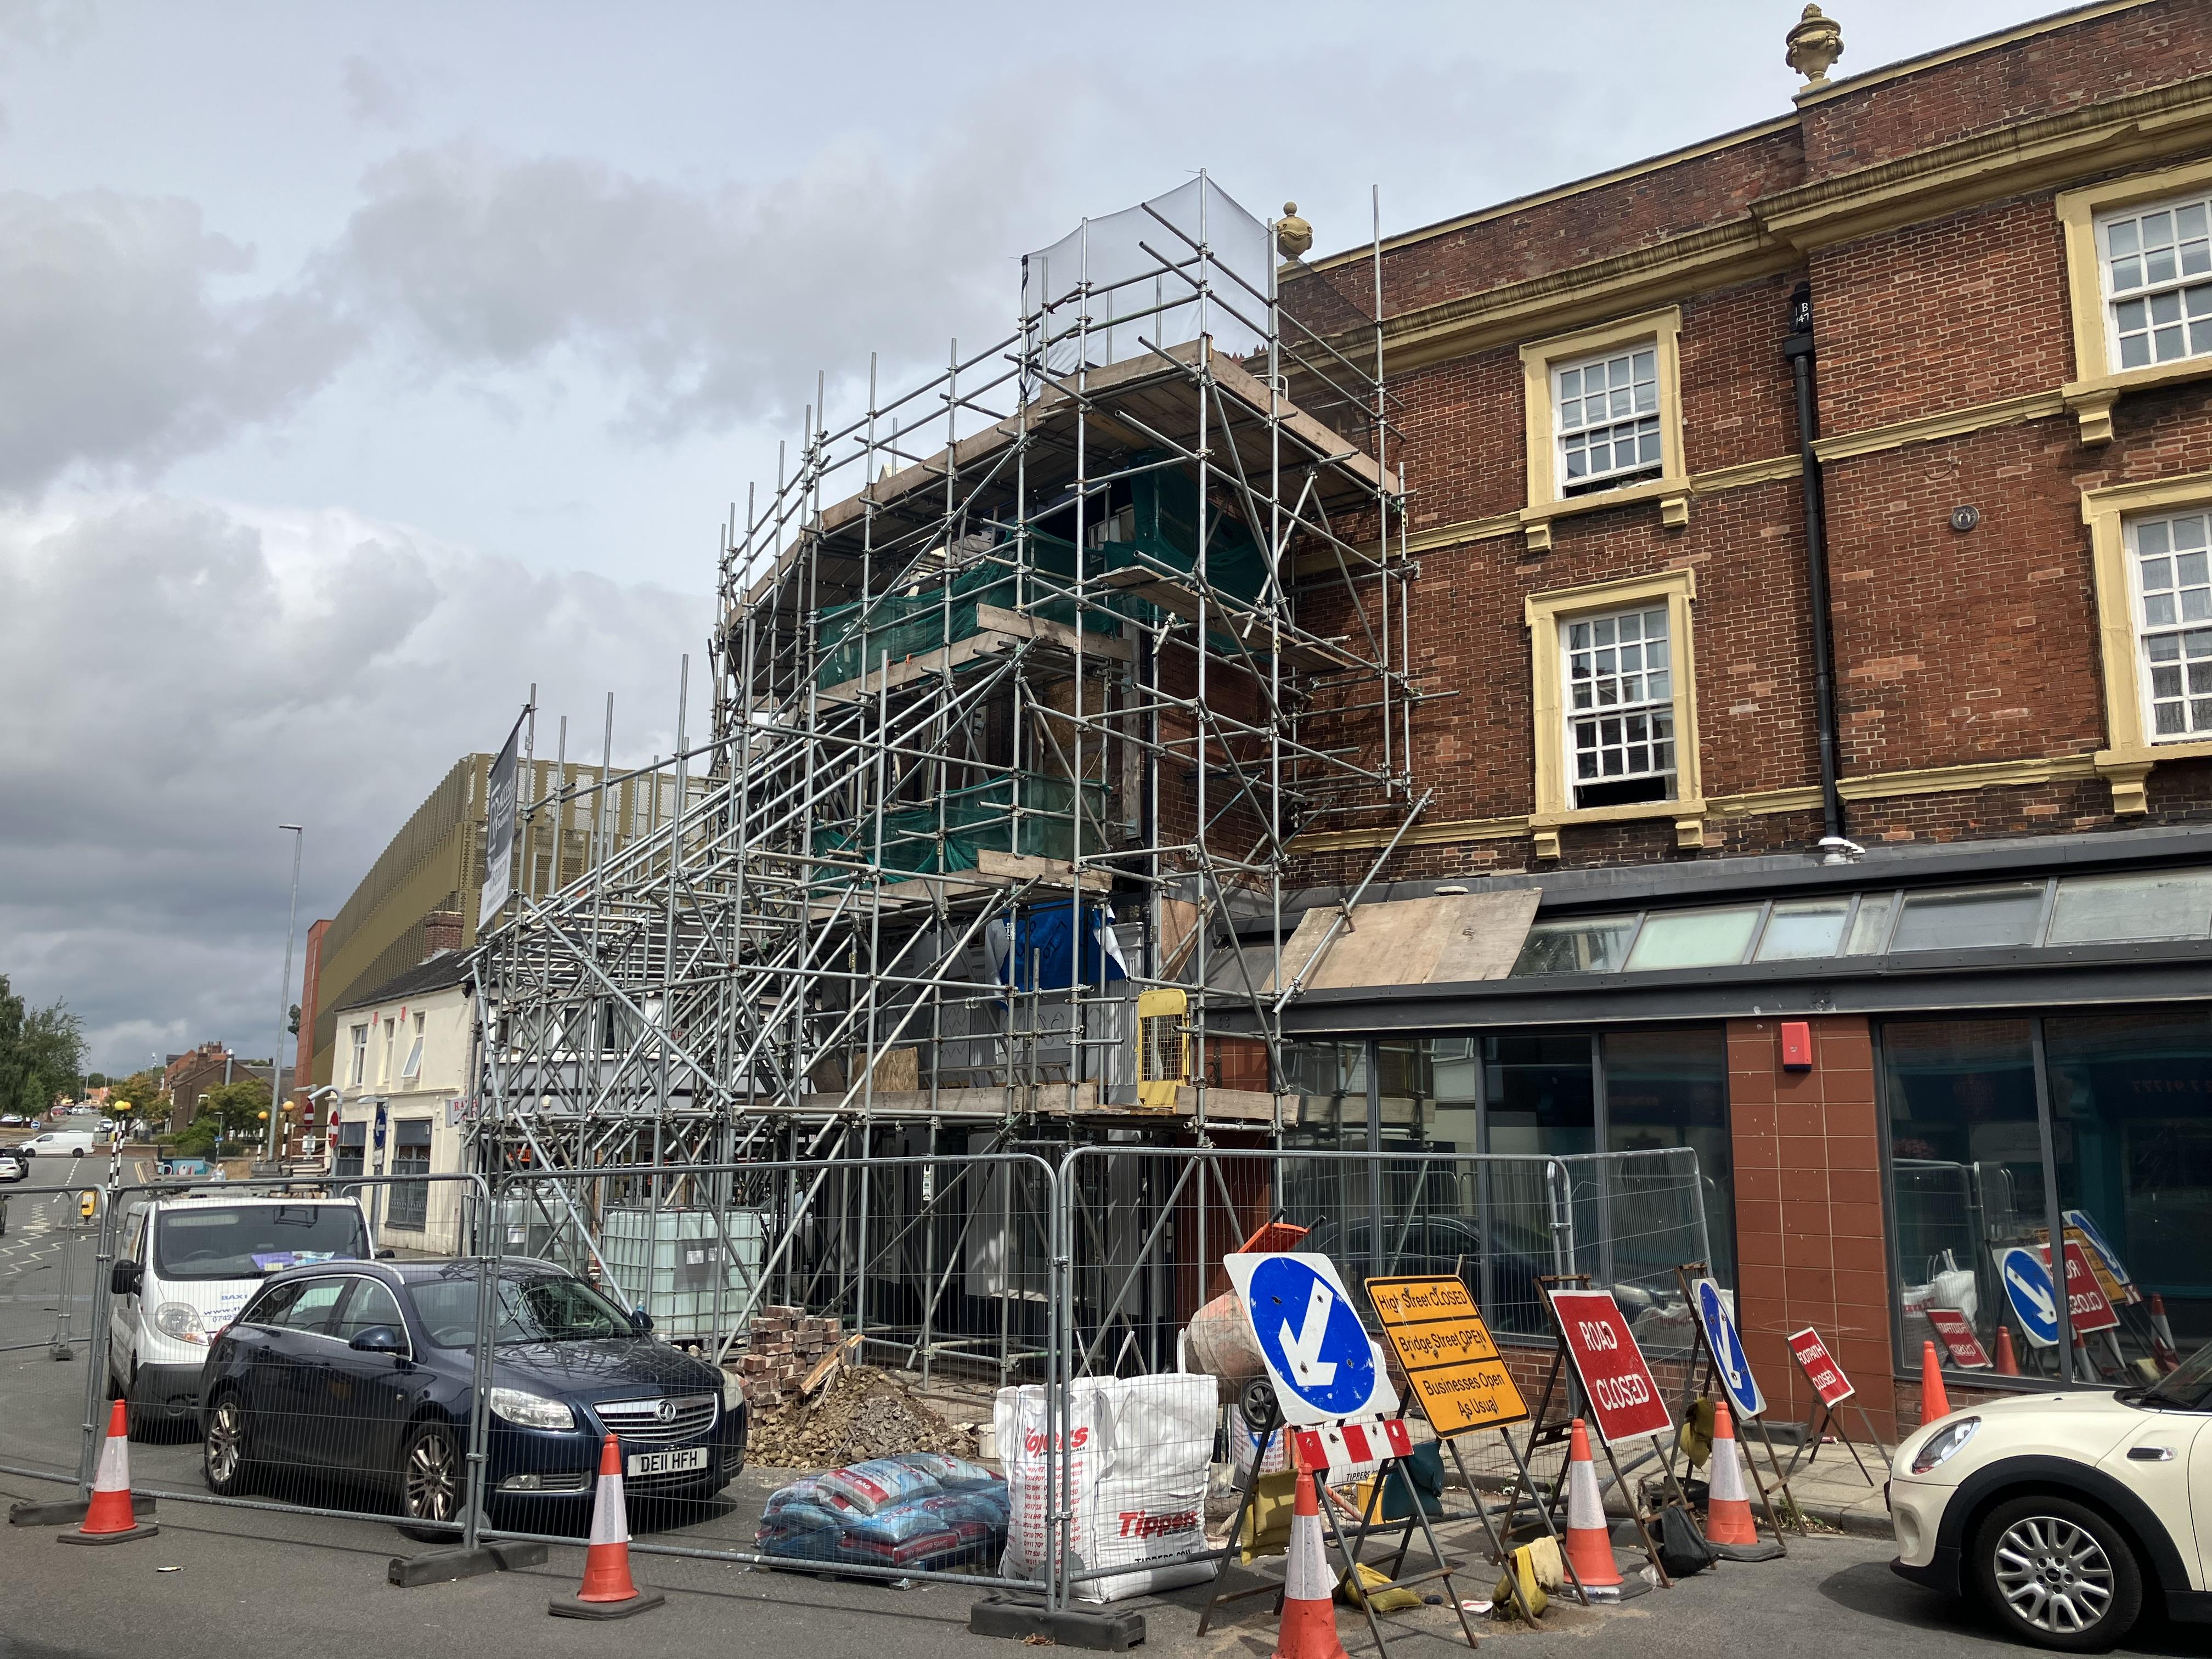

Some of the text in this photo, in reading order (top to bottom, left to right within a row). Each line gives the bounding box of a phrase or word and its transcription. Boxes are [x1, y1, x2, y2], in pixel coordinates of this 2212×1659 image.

[1376, 1290, 1467, 1313] High Street CLOSED
[1398, 1329, 1487, 1354] Bridge Street OPEN
[1578, 1321, 1618, 1352] ROAD
[1423, 1372, 1505, 1396] Businesses Open
[1596, 1373, 1650, 1411] CLOSED
[1812, 1370, 1837, 1391] CLOSED
[1457, 1395, 1499, 1417] As Usual
[641, 1451, 697, 1472] DE11 HFH
[1118, 1510, 1198, 1539] Tippers
